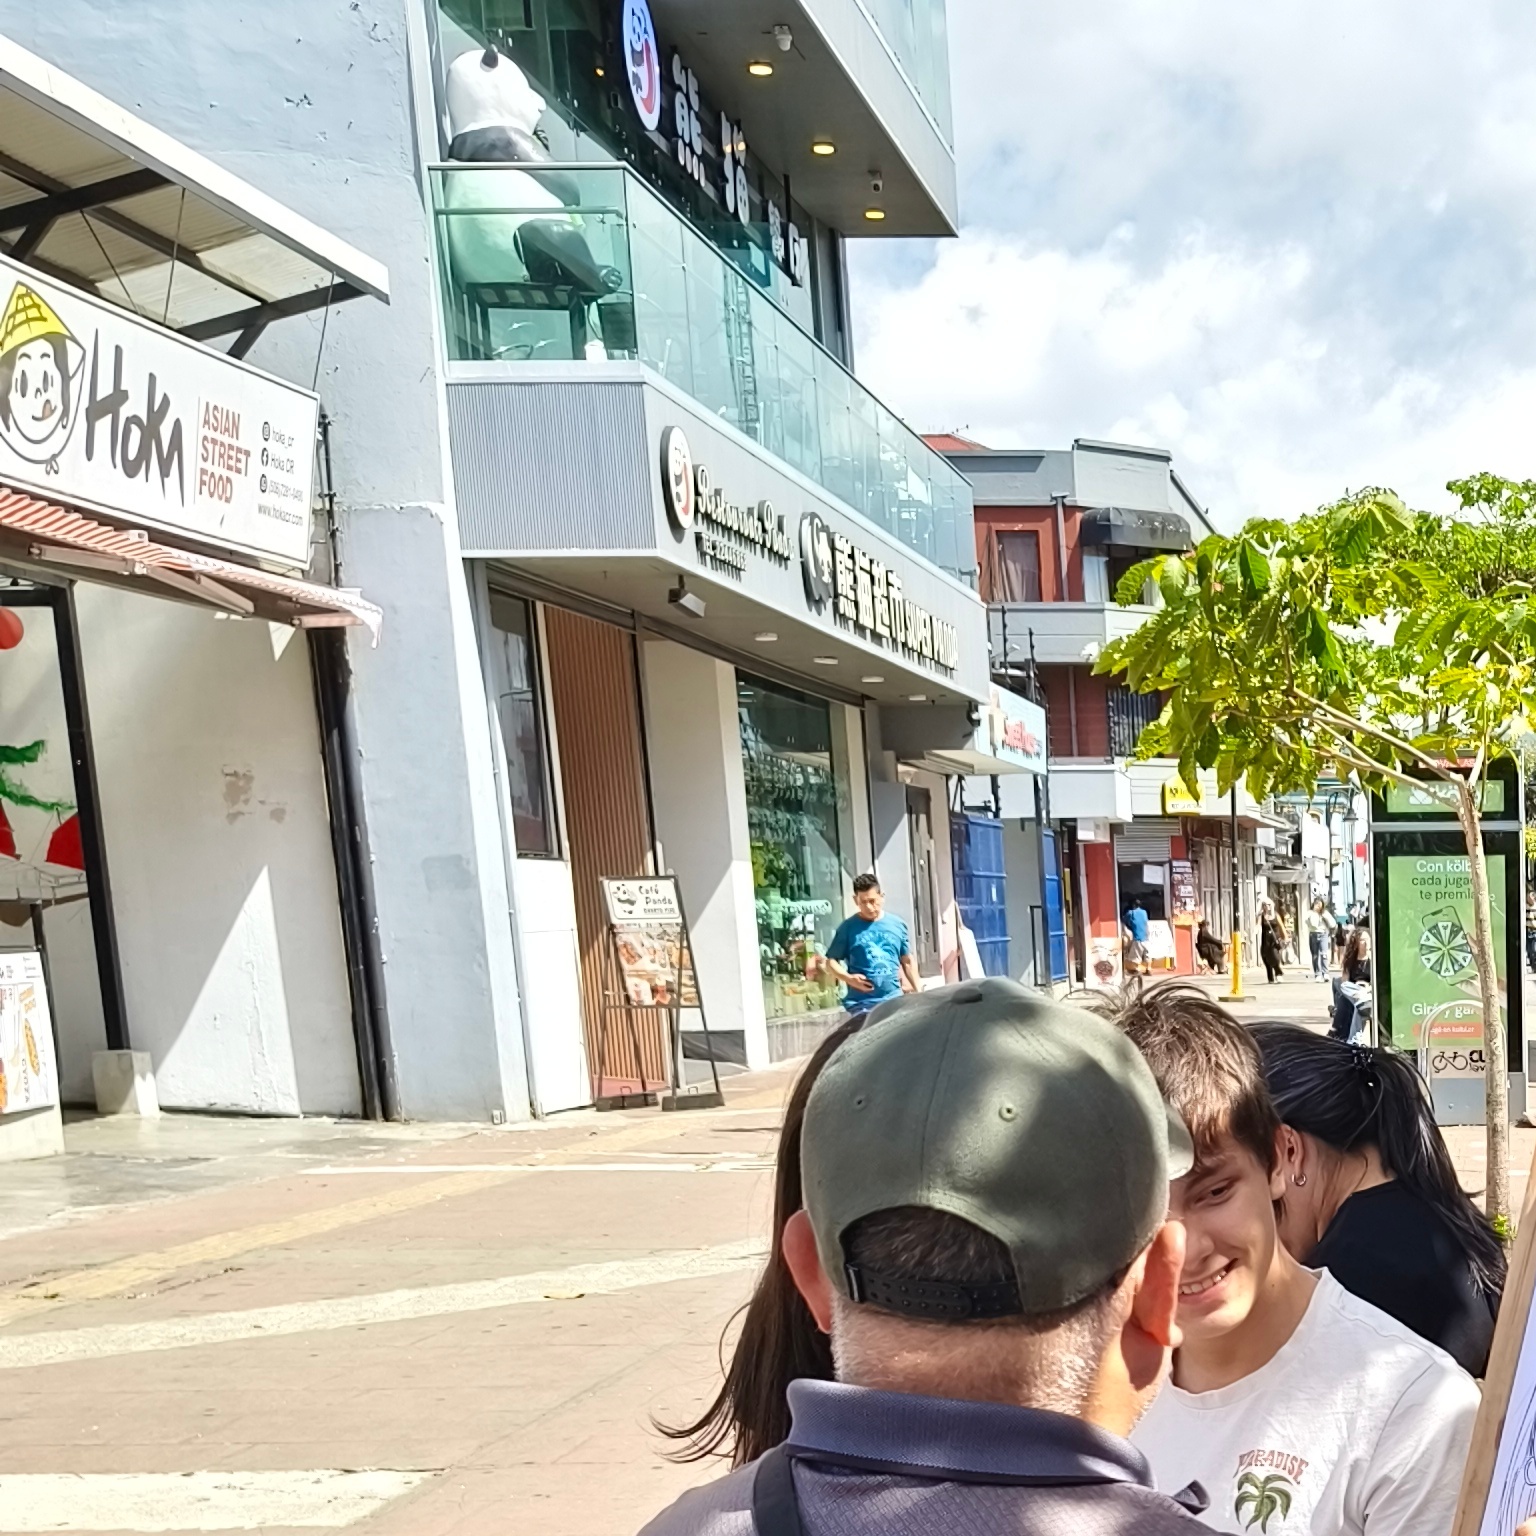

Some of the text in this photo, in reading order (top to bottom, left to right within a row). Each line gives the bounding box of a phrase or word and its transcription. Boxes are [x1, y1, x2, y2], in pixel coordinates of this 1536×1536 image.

[202, 401, 241, 441] ASIAN
[201, 435, 251, 478] STREET
[198, 467, 233, 504] FOOD
[905, 599, 959, 670] SUPER PANDA
[1411, 873, 1474, 889] cada juga
[1416, 859, 1473, 873] Con kölb
[645, 896, 673, 905] Panda
[1419, 889, 1432, 900] te
[1233, 1448, 1310, 1486] PARADISE
